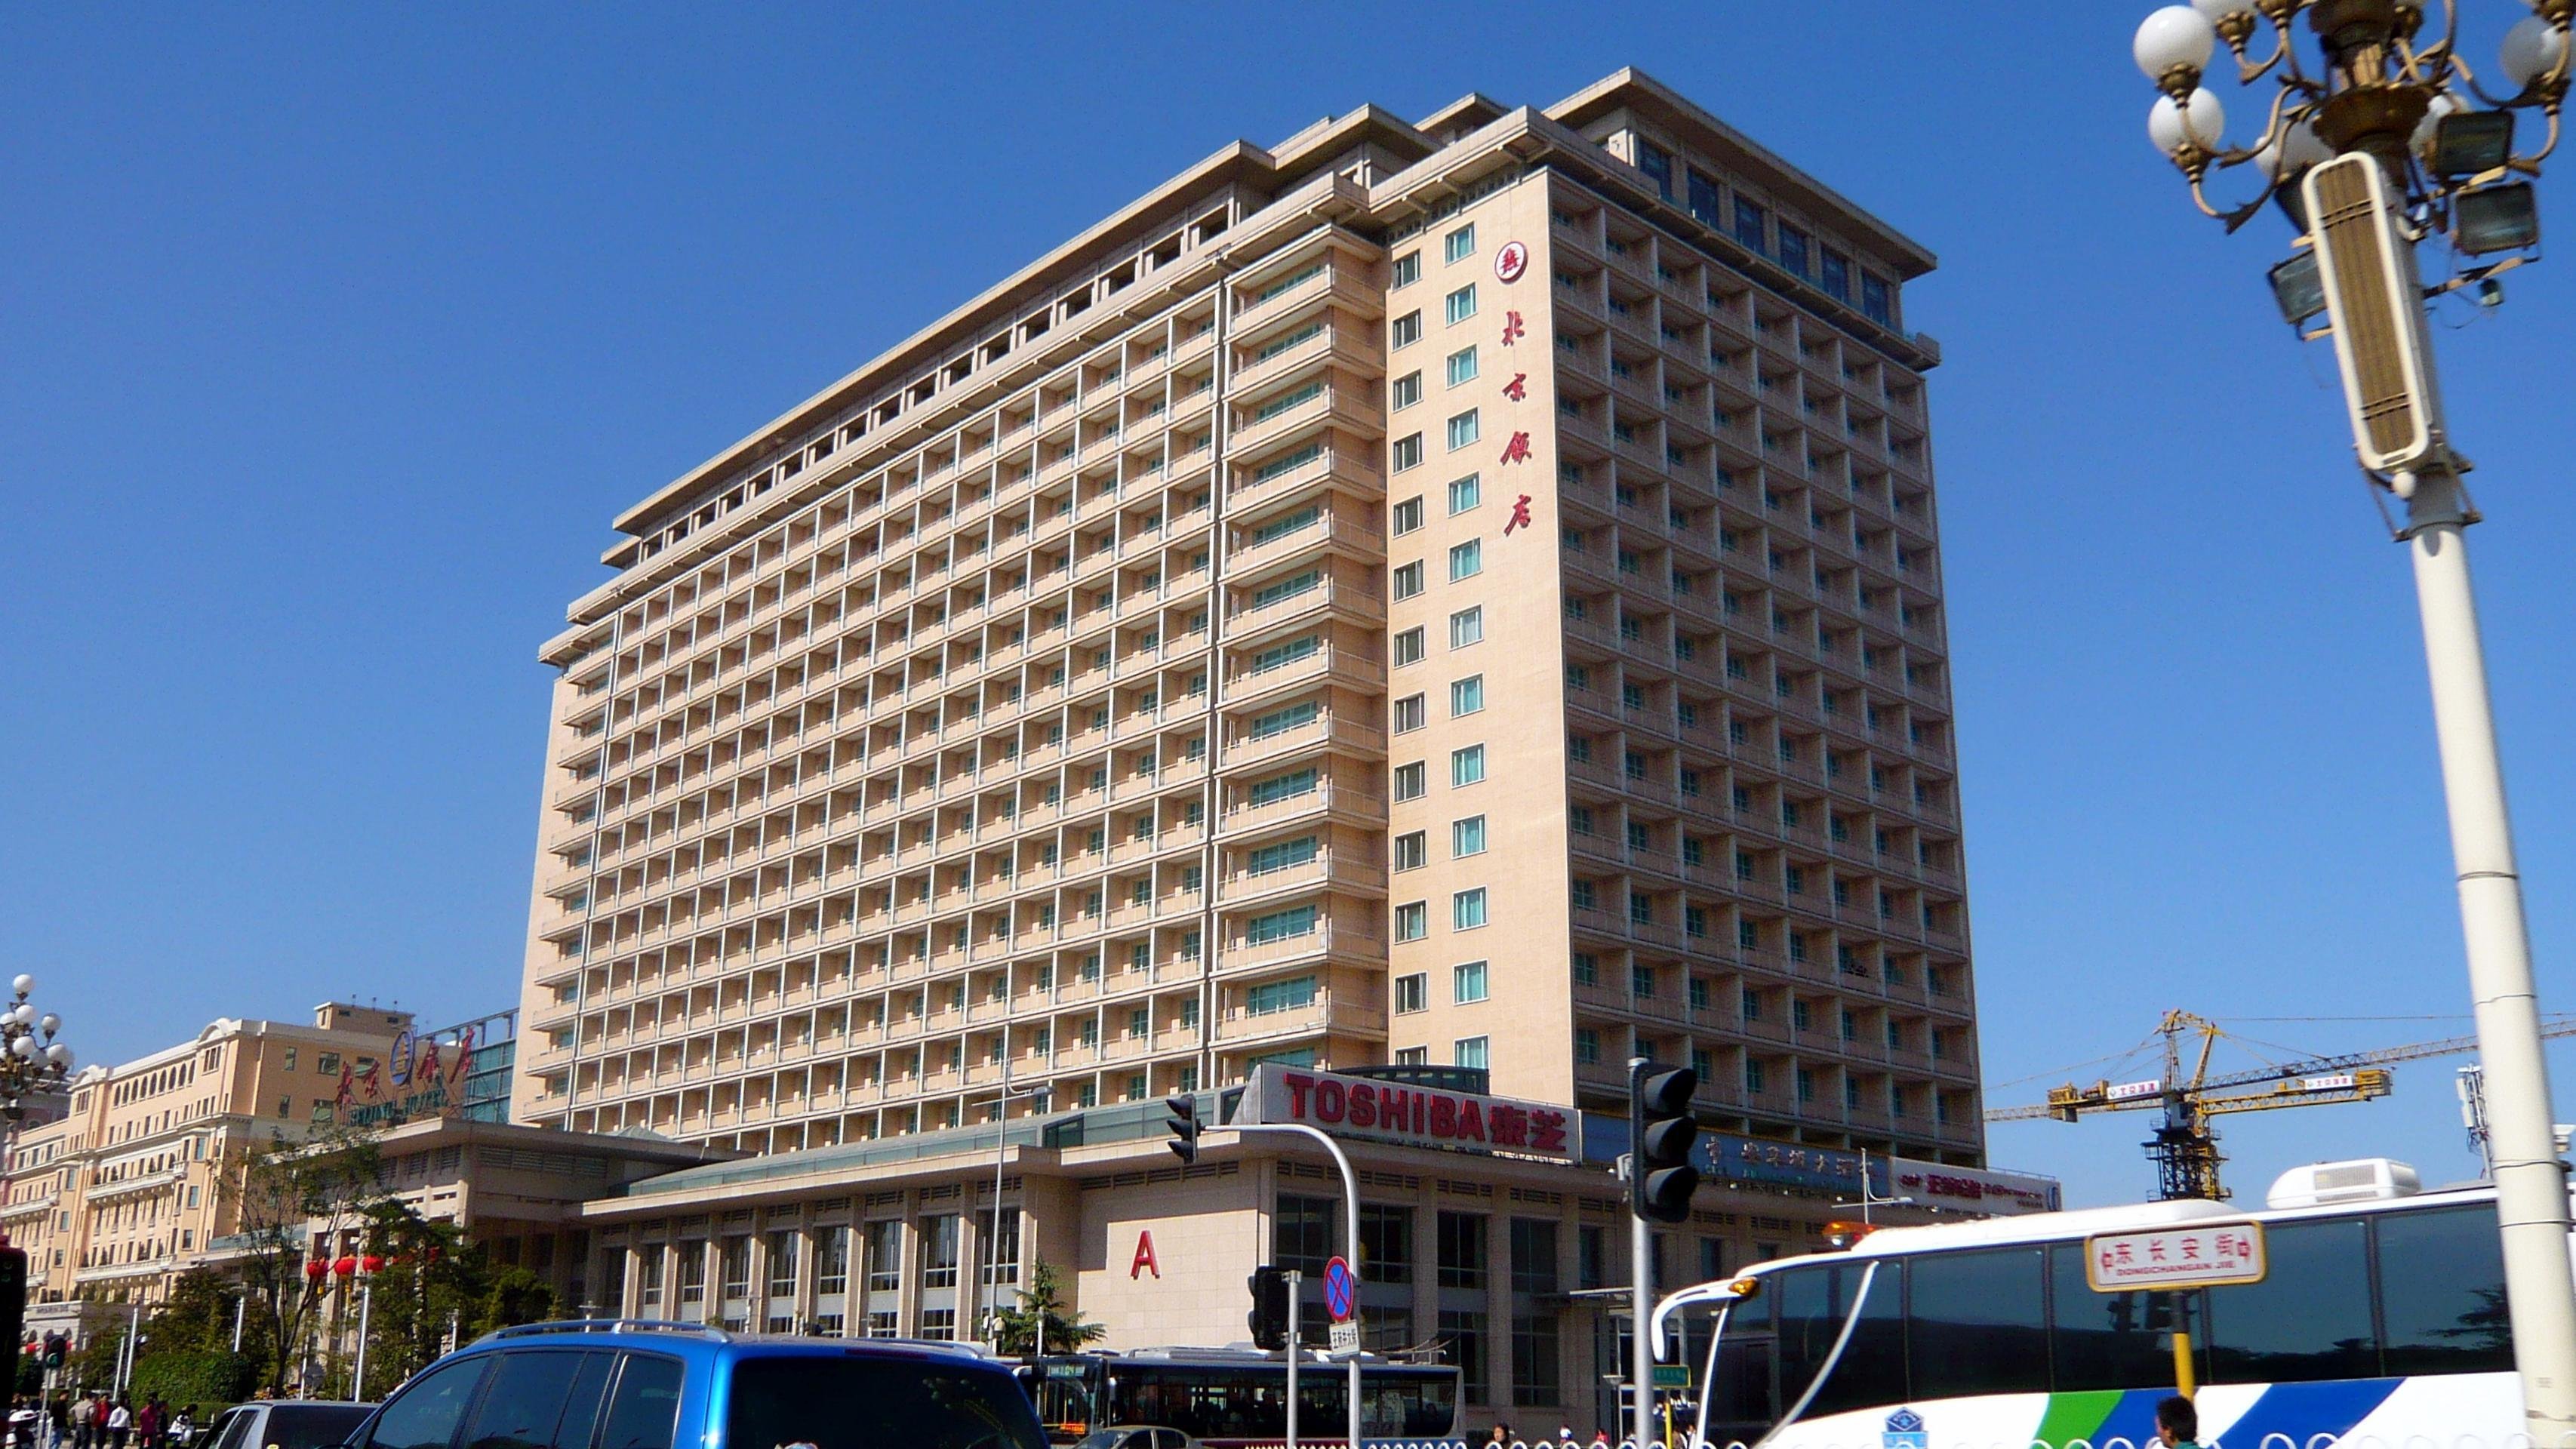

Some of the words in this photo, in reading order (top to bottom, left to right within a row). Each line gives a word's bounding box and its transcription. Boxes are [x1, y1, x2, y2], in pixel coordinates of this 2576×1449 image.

[1285, 1072, 1486, 1143] TOSHIBA
[1131, 1230, 1160, 1280] A
[2115, 1234, 2234, 1263] 东长安街
[2117, 1263, 2211, 1276] DONGCHANGAN
[2216, 1260, 2236, 1269] JIE
